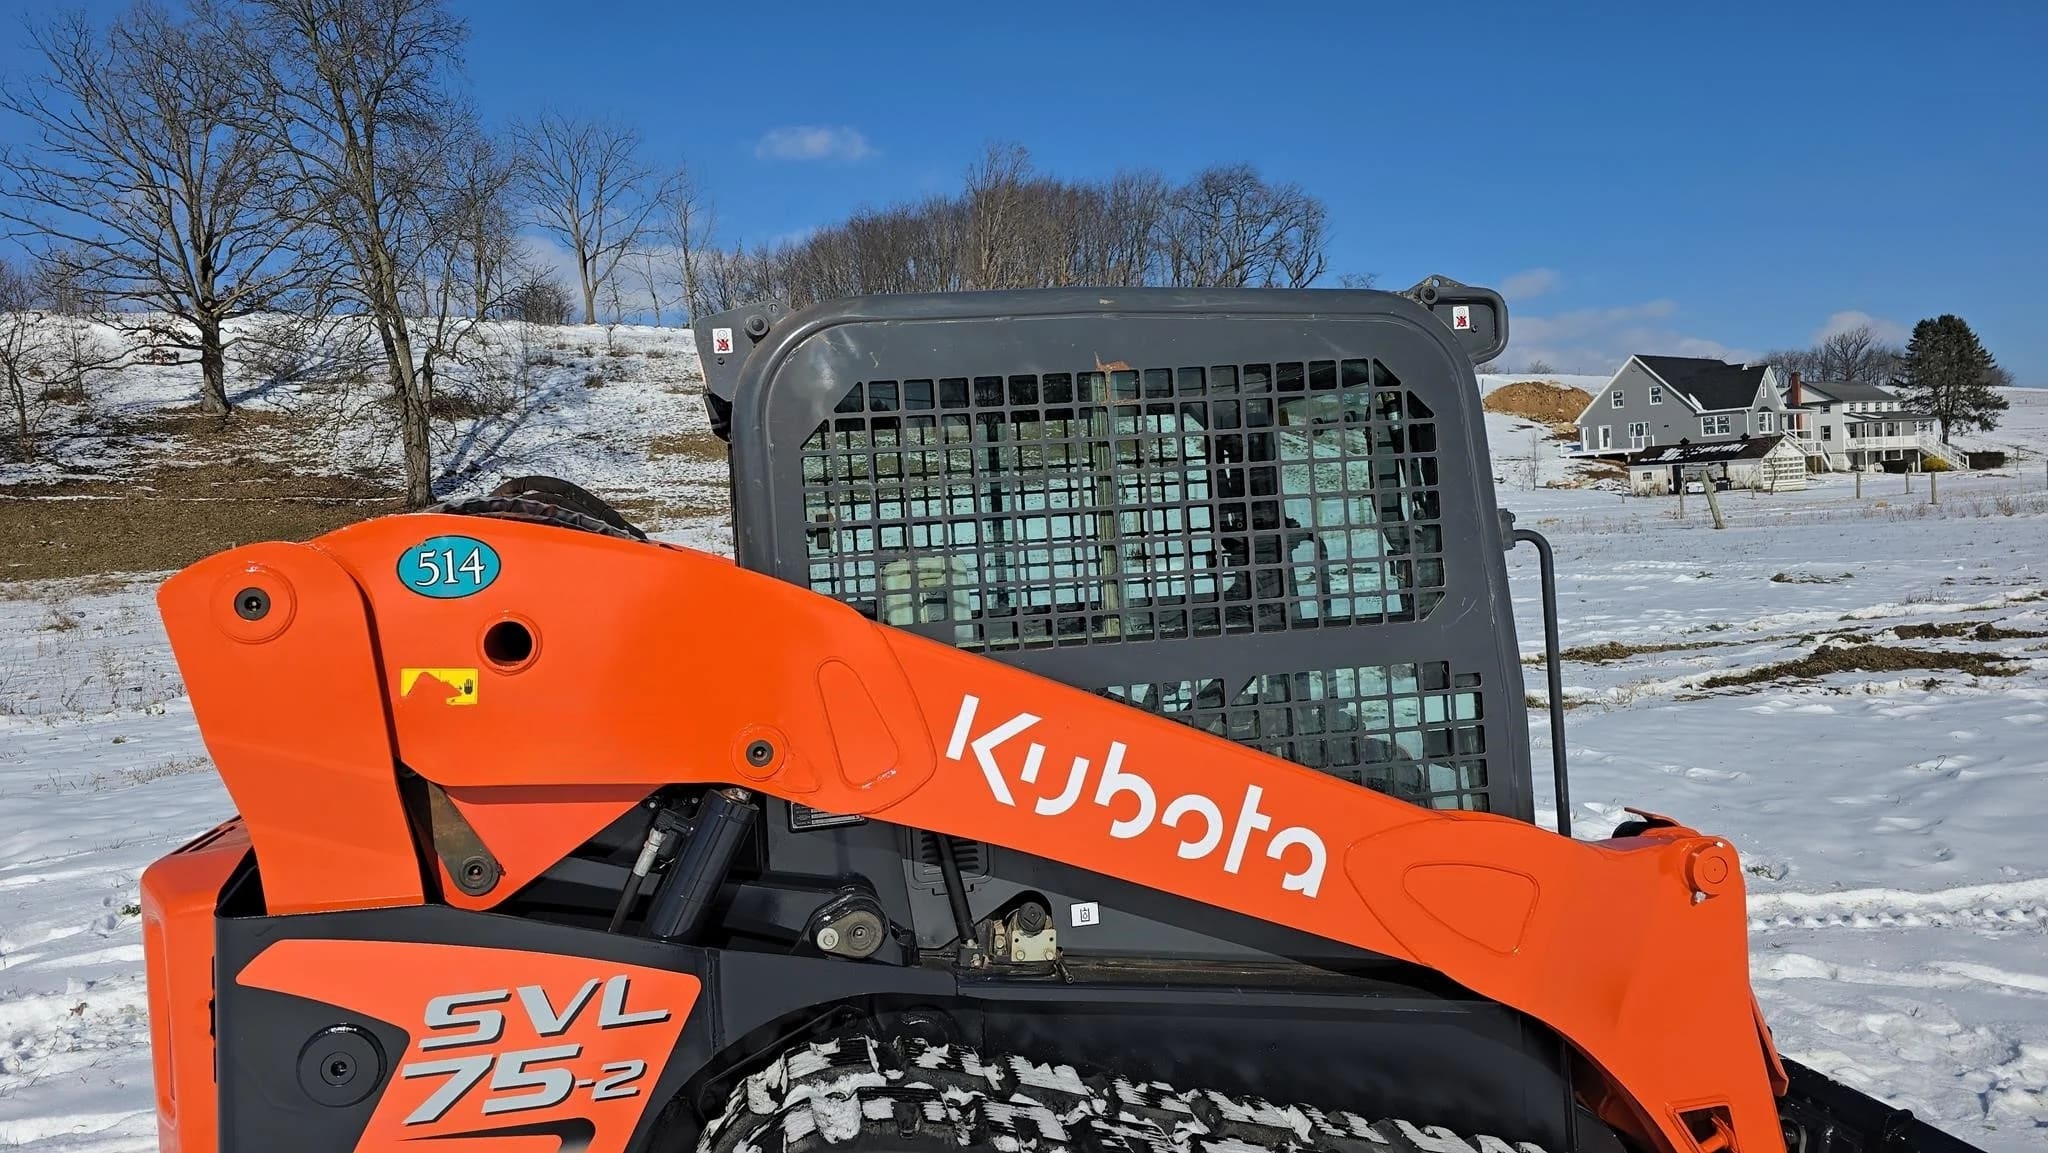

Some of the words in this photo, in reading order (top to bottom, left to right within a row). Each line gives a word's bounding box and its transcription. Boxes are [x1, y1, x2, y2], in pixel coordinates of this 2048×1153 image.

[415, 546, 486, 587] 514
[945, 693, 1327, 899] Kubota
[418, 974, 671, 1051] SVL
[401, 1043, 647, 1126] 75-2
